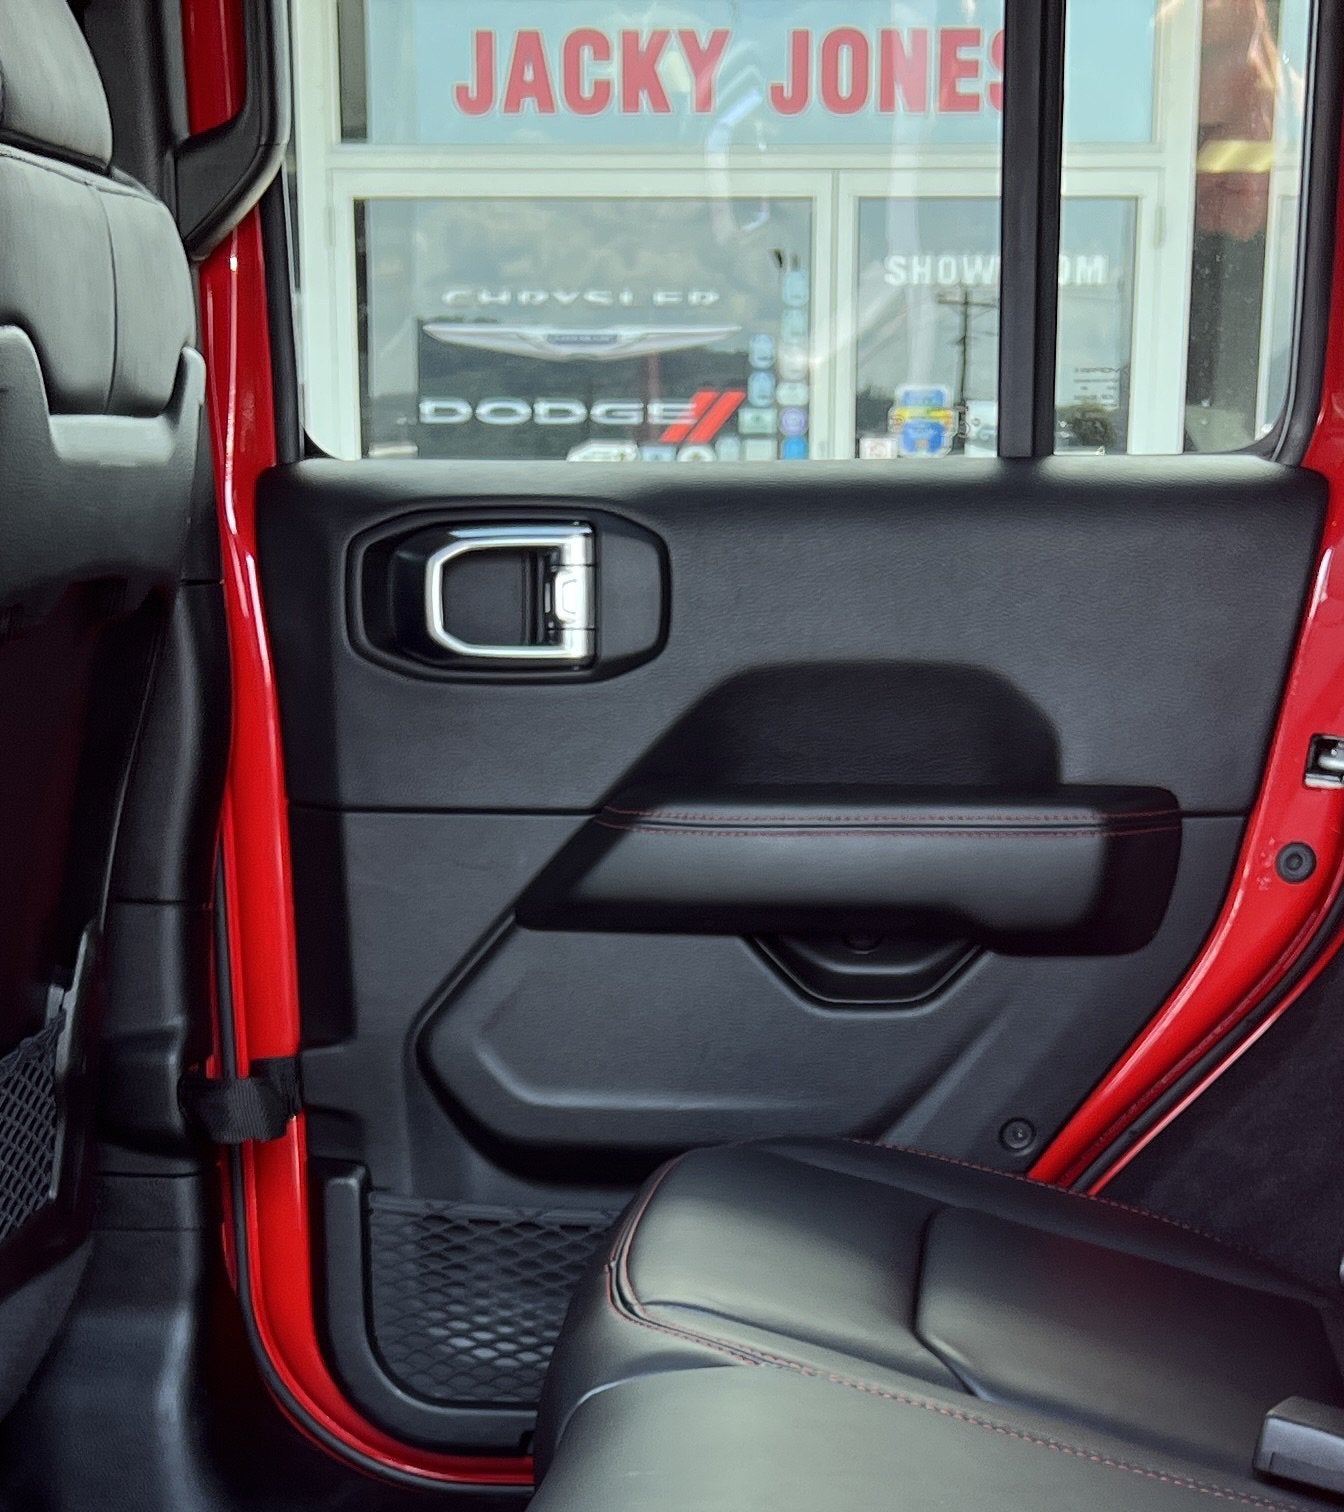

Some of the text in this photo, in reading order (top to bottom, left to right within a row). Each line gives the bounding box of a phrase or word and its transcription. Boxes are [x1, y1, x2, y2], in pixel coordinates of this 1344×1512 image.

[453, 27, 1003, 116] JACKY JONE
[884, 254, 1107, 286] SHOWOM
[418, 397, 698, 426] DODGE
